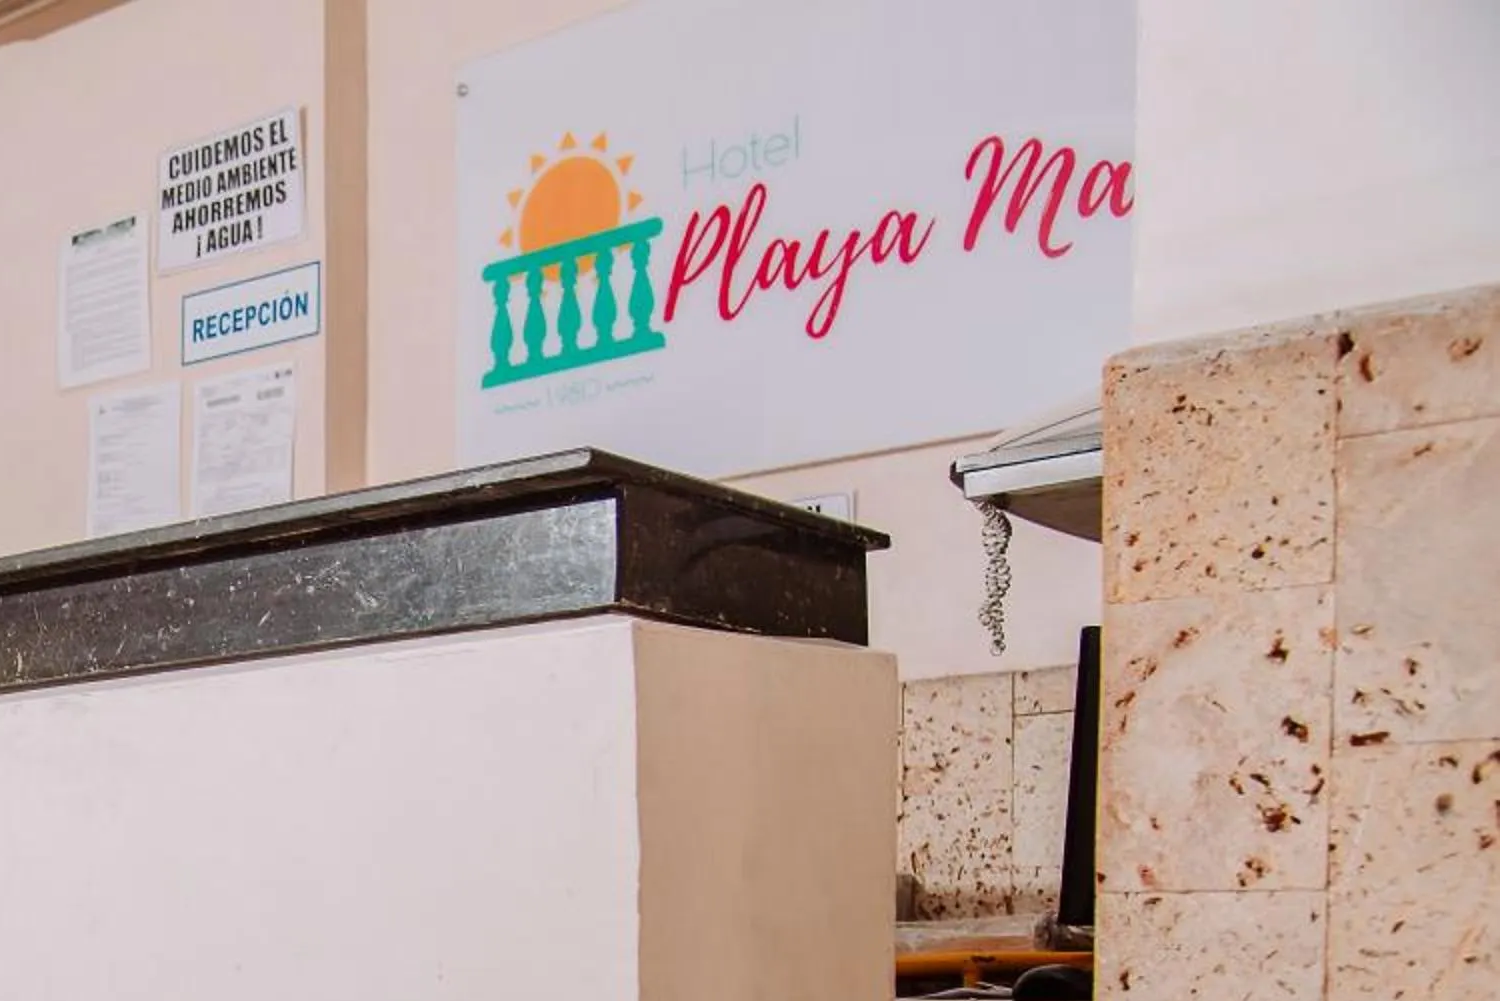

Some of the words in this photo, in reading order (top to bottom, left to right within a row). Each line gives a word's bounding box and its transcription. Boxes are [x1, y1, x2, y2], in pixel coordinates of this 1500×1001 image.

[161, 175, 213, 210] MEDIO
[216, 147, 297, 194] AMBIENTE
[168, 127, 264, 179] CUIDEMOS
[269, 118, 289, 146] EL
[681, 114, 801, 188] Hotel
[171, 181, 288, 234] AHORREMOS
[663, 182, 936, 339] Playa
[192, 290, 309, 343] RECEPCIÓN
